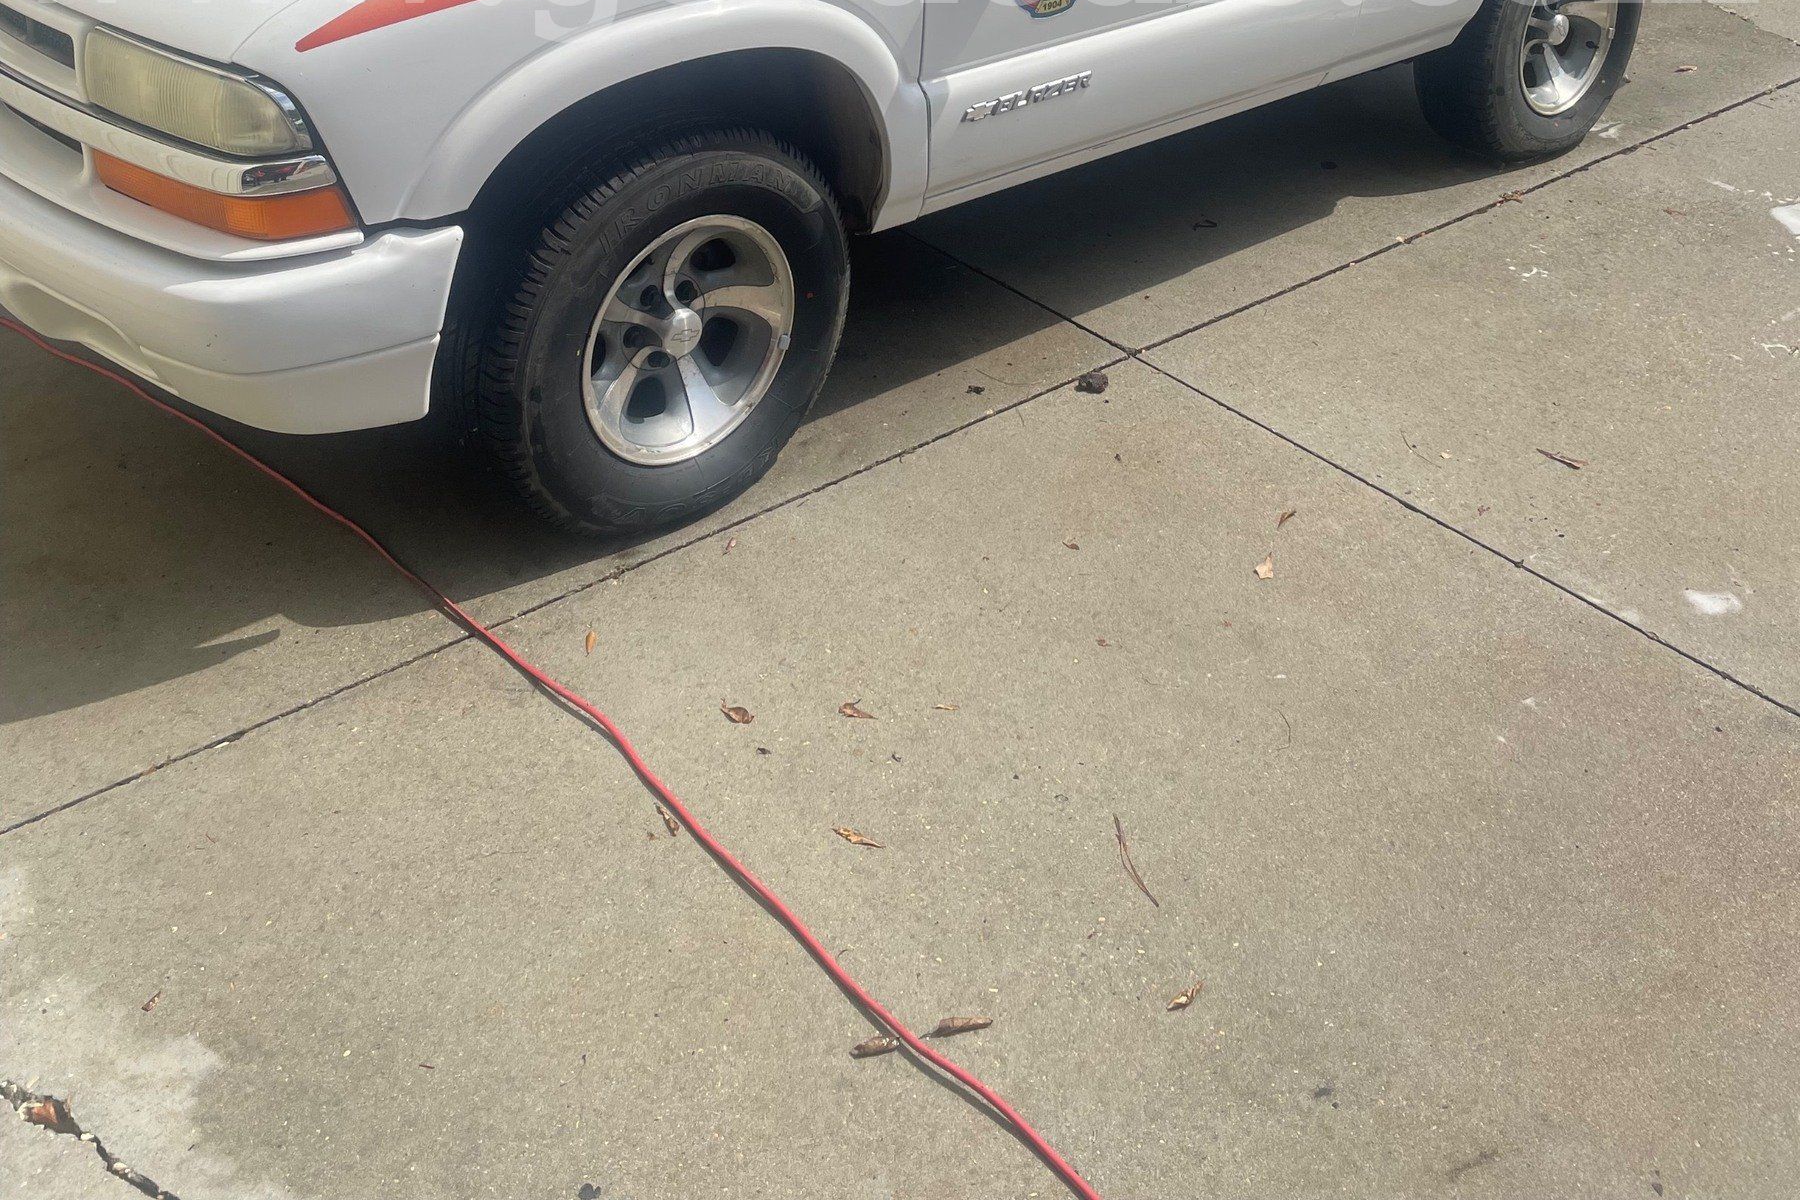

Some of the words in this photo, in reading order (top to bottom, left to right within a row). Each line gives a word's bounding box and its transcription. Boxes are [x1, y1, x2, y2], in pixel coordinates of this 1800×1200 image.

[1042, 0, 1063, 12] 1904
[991, 69, 1092, 115] BLAZER
[597, 160, 795, 257] IRONMAN
